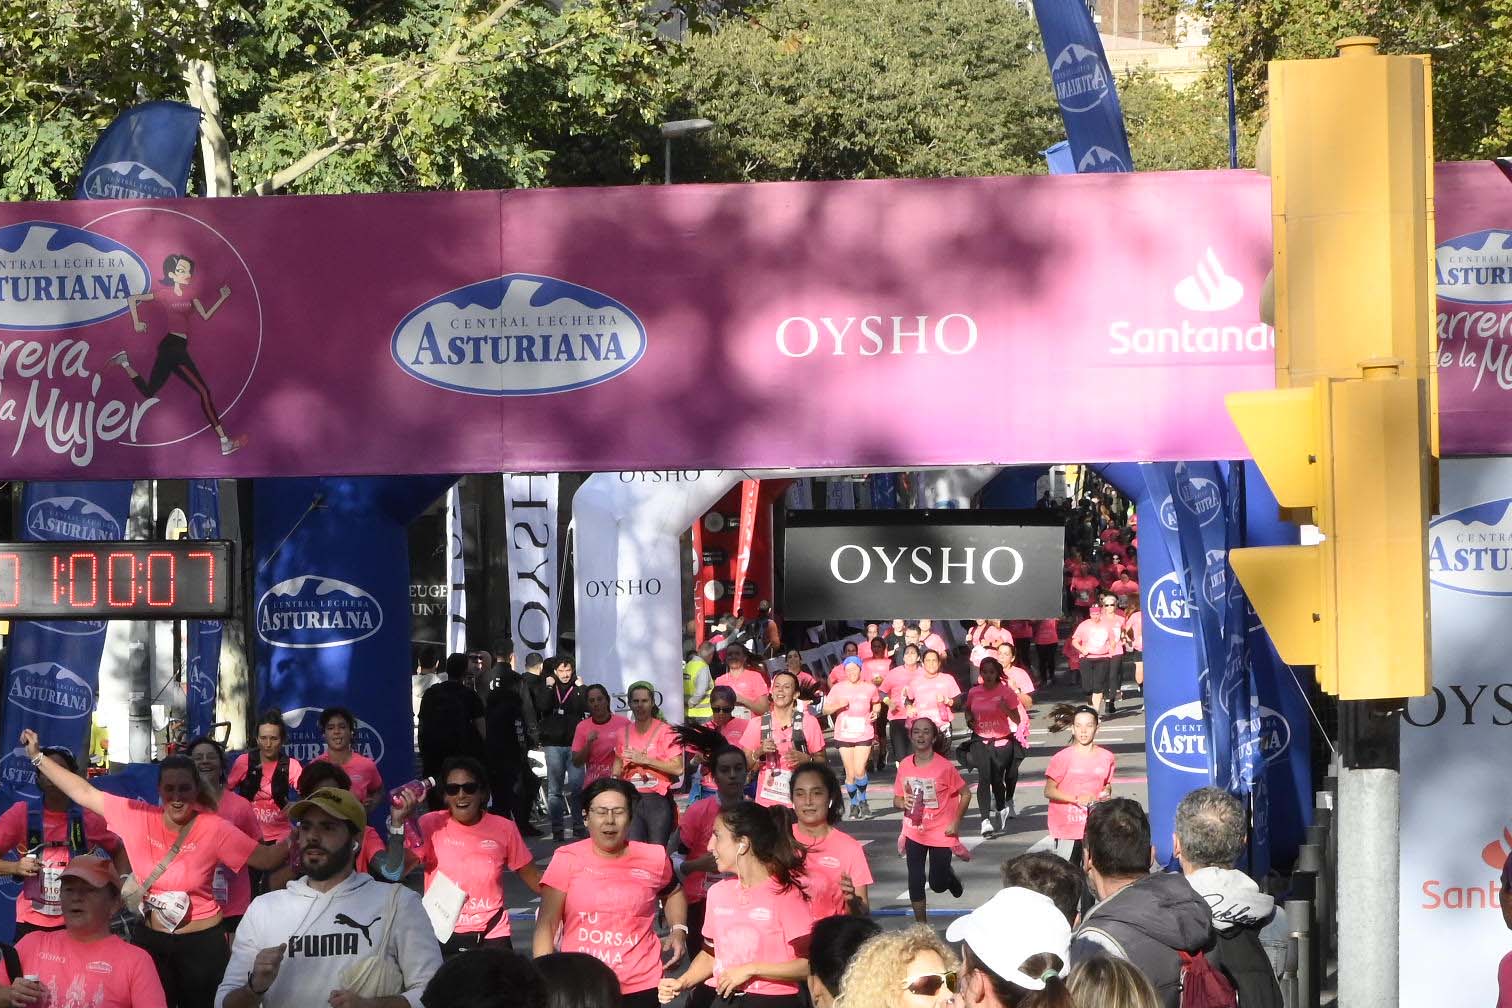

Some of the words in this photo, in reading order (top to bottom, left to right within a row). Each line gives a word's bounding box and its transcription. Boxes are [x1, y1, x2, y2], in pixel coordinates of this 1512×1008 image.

[54, 257, 126, 269] LECHERA
[450, 316, 528, 330] CENTRAL
[536, 314, 618, 328] LECHERA
[775, 312, 979, 358] OYSHO
[411, 321, 627, 367] ASTURIANA
[1459, 340, 1477, 368] la
[12, 373, 160, 467] Mujer
[511, 472, 552, 651] OYSH
[830, 544, 1024, 586] OYSHO
[585, 577, 662, 599] OYSHO
[260, 604, 374, 632] ASTURIANA
[7, 679, 88, 712] ASTURIANA
[1174, 724, 1202, 732] CENT
[578, 911, 599, 924] TU
[288, 932, 359, 958] PUMA
